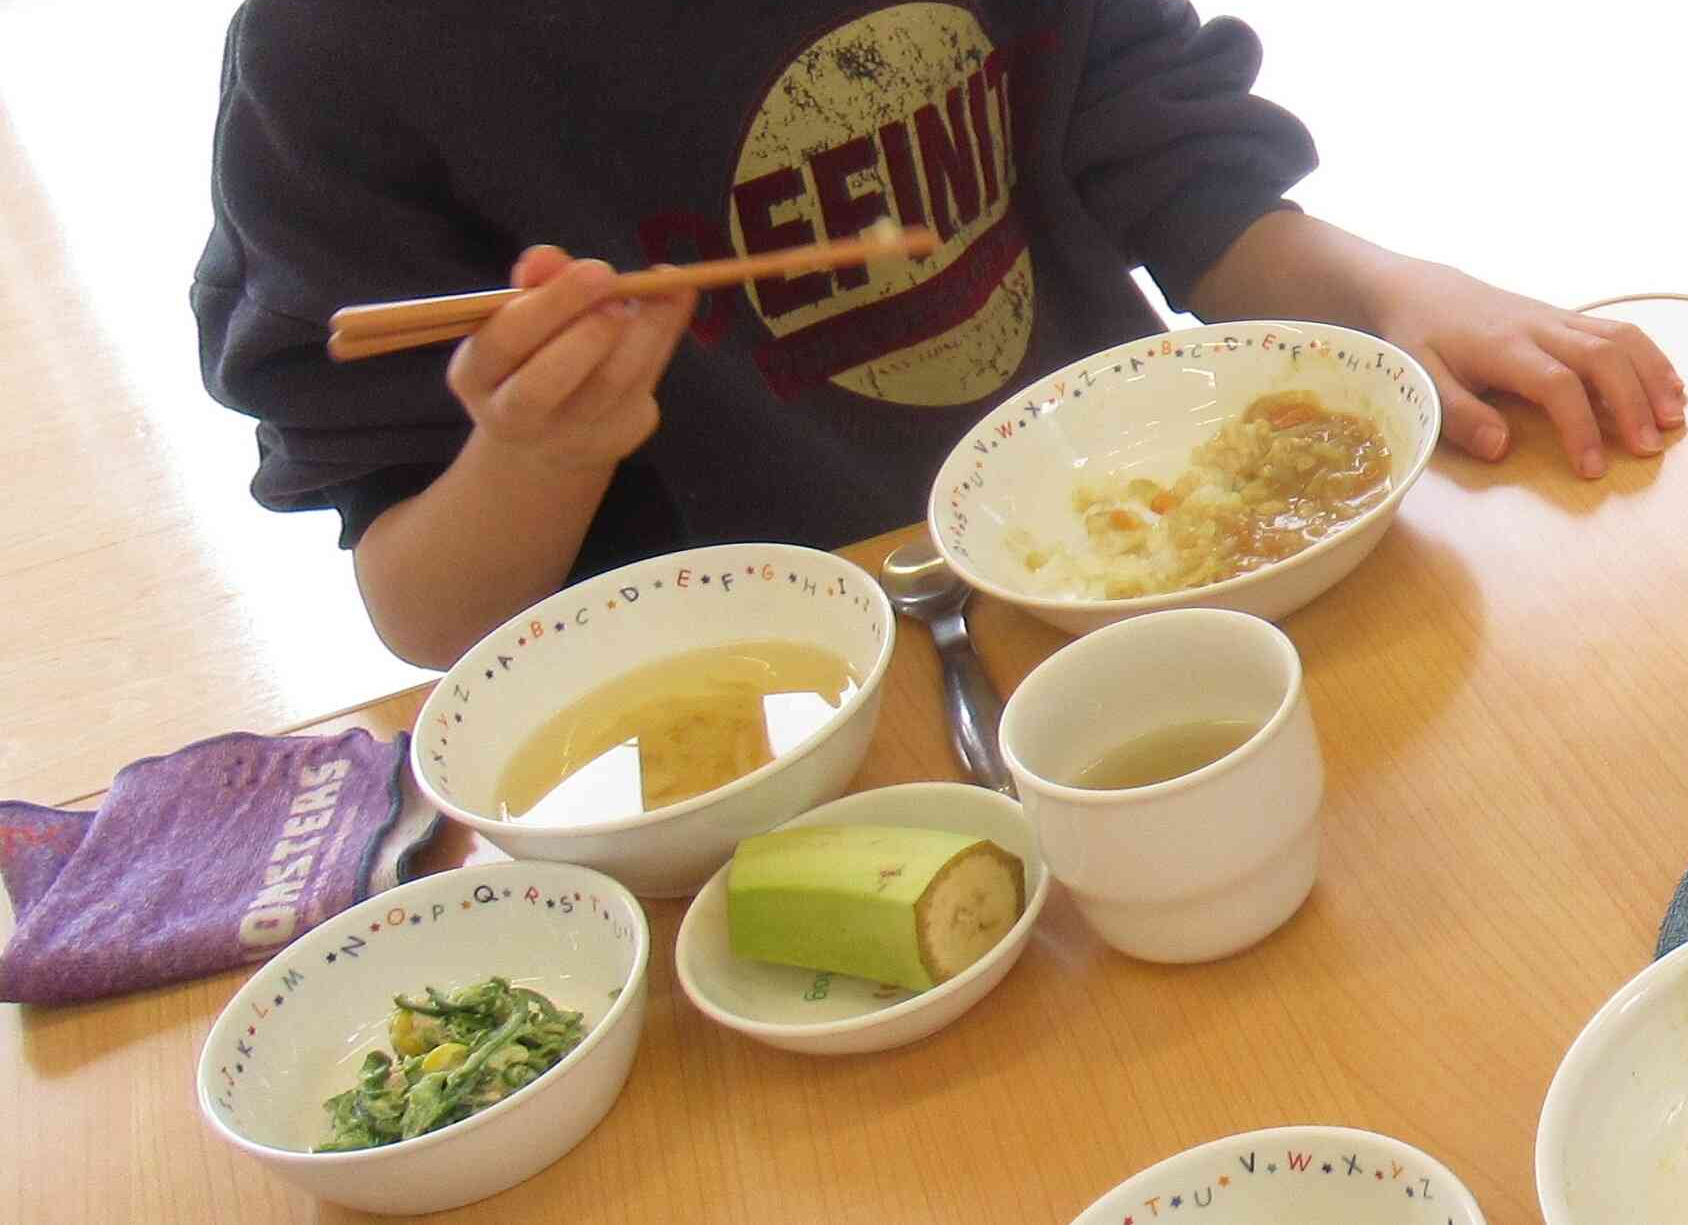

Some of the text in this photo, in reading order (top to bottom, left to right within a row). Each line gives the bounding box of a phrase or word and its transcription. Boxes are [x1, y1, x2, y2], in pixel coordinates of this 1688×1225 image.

[974, 439, 989, 454] V
[994, 422, 1013, 439] W
[1024, 401, 1040, 417] X
[1055, 382, 1065, 397] Y
[1078, 370, 1096, 387] Z
[1130, 358, 1144, 372] A
[1262, 333, 1276, 350] E
[1291, 345, 1302, 362] F
[1346, 354, 1360, 372] H
[1375, 352, 1385, 369] I
[453, 683, 470, 703] Z
[498, 656, 514, 671] A
[530, 621, 545, 639] B
[575, 607, 591, 627] C
[619, 586, 640, 604] D
[676, 569, 693, 589] E
[721, 573, 736, 593] F
[760, 564, 776, 581] G
[803, 576, 817, 596] H
[838, 577, 847, 595] I
[239, 758, 351, 948] ONSTERS
[237, 1038, 254, 1059] K
[251, 1002, 270, 1019] L
[282, 968, 305, 993] M
[341, 935, 367, 958] N
[387, 908, 405, 926] O
[432, 904, 446, 922] P
[474, 884, 500, 906] Q
[524, 886, 540, 906] R
[560, 895, 574, 914] S
[1144, 1151, 1434, 1217] T U V W X Y Z
